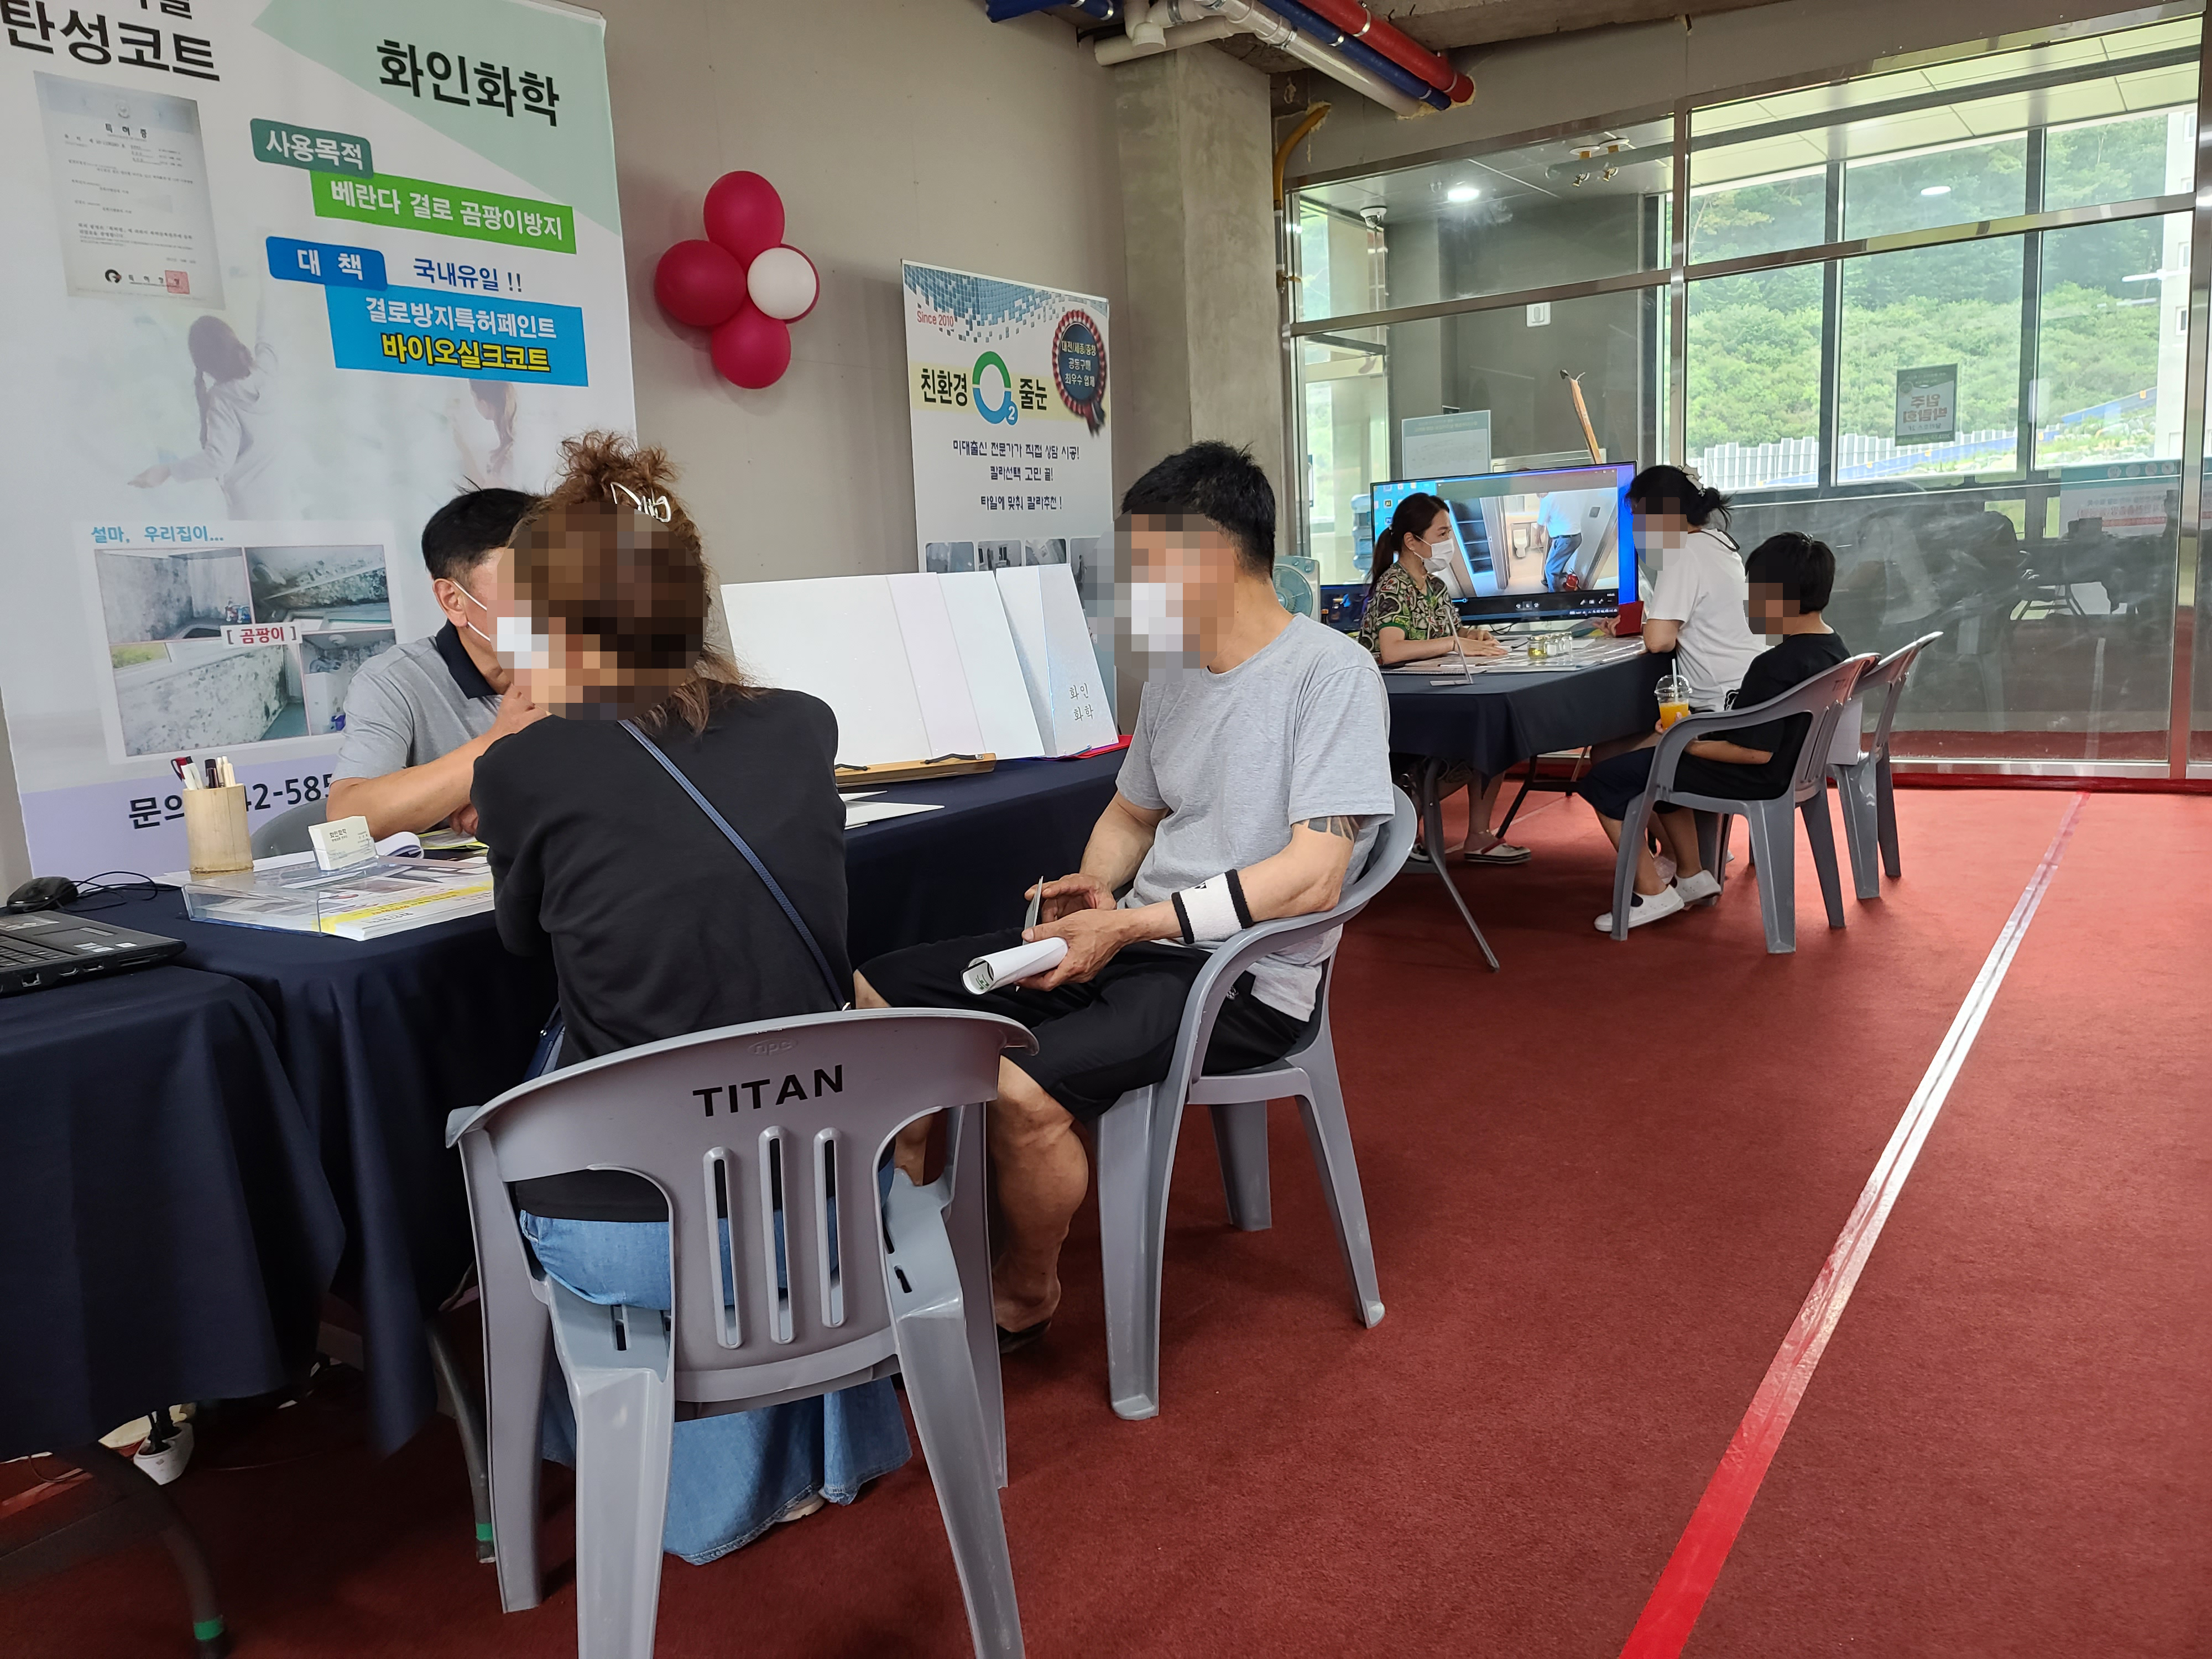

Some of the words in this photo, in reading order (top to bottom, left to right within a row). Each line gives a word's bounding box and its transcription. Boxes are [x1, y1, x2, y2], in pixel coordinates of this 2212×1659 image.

[1, 0, 220, 81] 탄성코트
[377, 39, 560, 127] 화인화학
[266, 129, 364, 170] 사용목적
[331, 179, 401, 216] 베란다
[410, 190, 453, 221] 결로
[460, 200, 563, 241] 곰팡이방지
[413, 258, 500, 293] 국내유일
[365, 297, 557, 340] 결로방지특허페인트
[917, 310, 937, 325] Since
[938, 314, 954, 327] 2010
[381, 333, 552, 373] 바이오실크코트
[921, 368, 968, 406] 친환경
[1019, 378, 1047, 410] 줄눈
[953, 440, 988, 456] 미대출신
[991, 442, 1022, 458] 전문가가
[1025, 444, 1042, 458] 직접
[1045, 445, 1058, 460] 상담
[1061, 446, 1079, 460] 시공!
[990, 466, 1021, 481] 칼라선택
[1025, 467, 1041, 481] 고민
[1044, 467, 1053, 482] 끝!
[980, 495, 1005, 510] 타일에
[1008, 495, 1024, 510] 맞춰
[91, 526, 131, 544] 설마,
[144, 525, 225, 544] 우리집이...
[1069, 682, 1089, 700] 화인
[1073, 704, 1094, 722] 화학
[692, 1064, 843, 1118] TITAN
